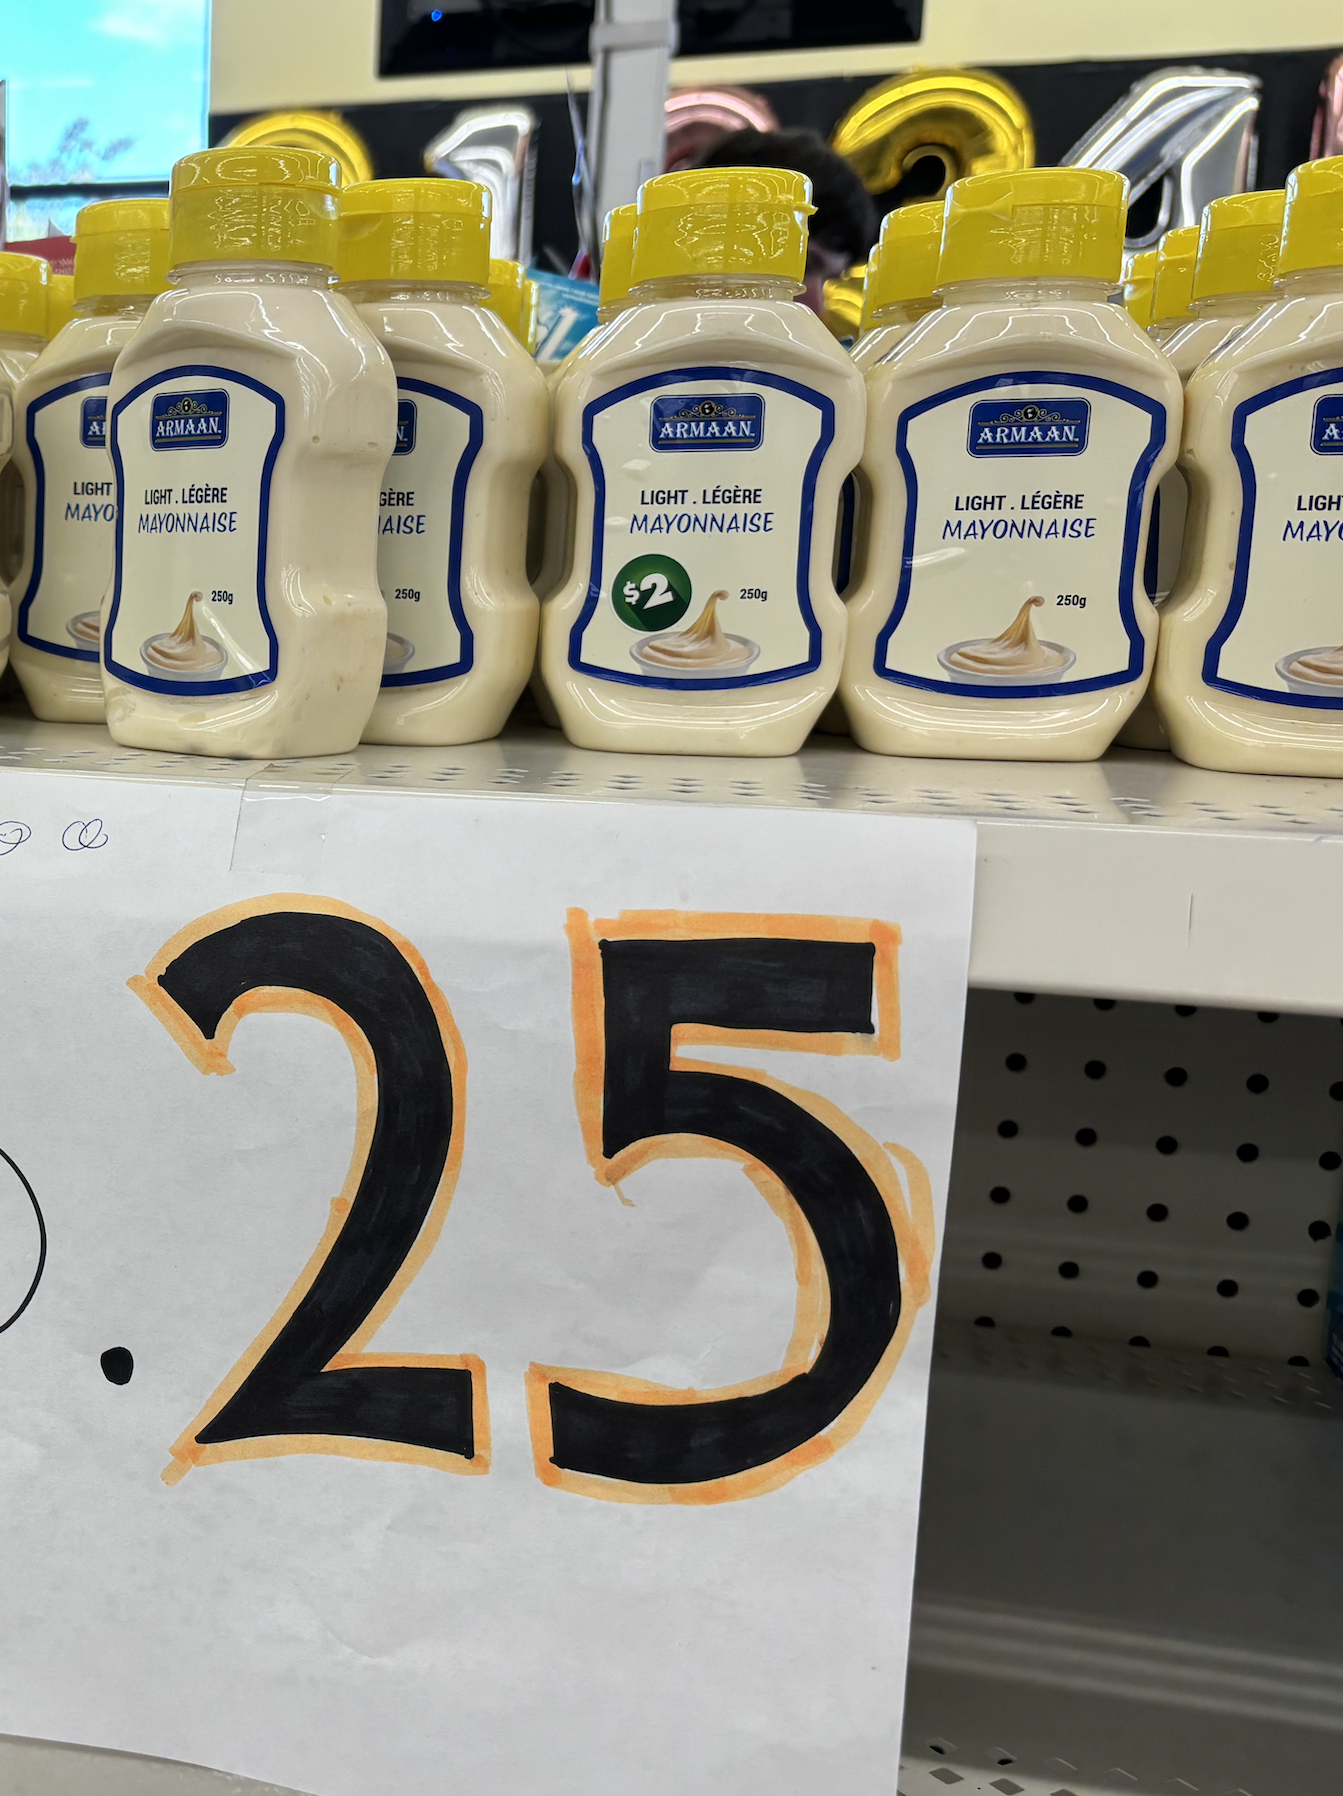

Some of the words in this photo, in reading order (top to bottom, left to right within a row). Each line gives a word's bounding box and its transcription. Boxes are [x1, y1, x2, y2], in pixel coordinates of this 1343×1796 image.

[156, 416, 220, 437] ARMAAN
[658, 419, 752, 438] ARMAAN
[976, 422, 1077, 443] ARMAAN
[74, 482, 112, 495] LIGHT
[145, 489, 172, 504] LIGHT
[182, 484, 227, 503] LÉGÈRE
[641, 490, 688, 505] LIGHT
[703, 485, 762, 504] LÉGÈRE
[955, 495, 1006, 510] LIGHT
[1021, 491, 1084, 509] LÉGÈRE
[139, 512, 237, 533] MAYONNAISE
[378, 514, 426, 536] AISE
[630, 513, 774, 534] MAYONNAISE
[943, 518, 1096, 540] MAYONNAISE
[212, 591, 233, 604] 250g
[395, 589, 420, 602] 250g
[624, 573, 673, 610] $2
[740, 589, 767, 601] 250g
[1057, 595, 1086, 608] 250g
